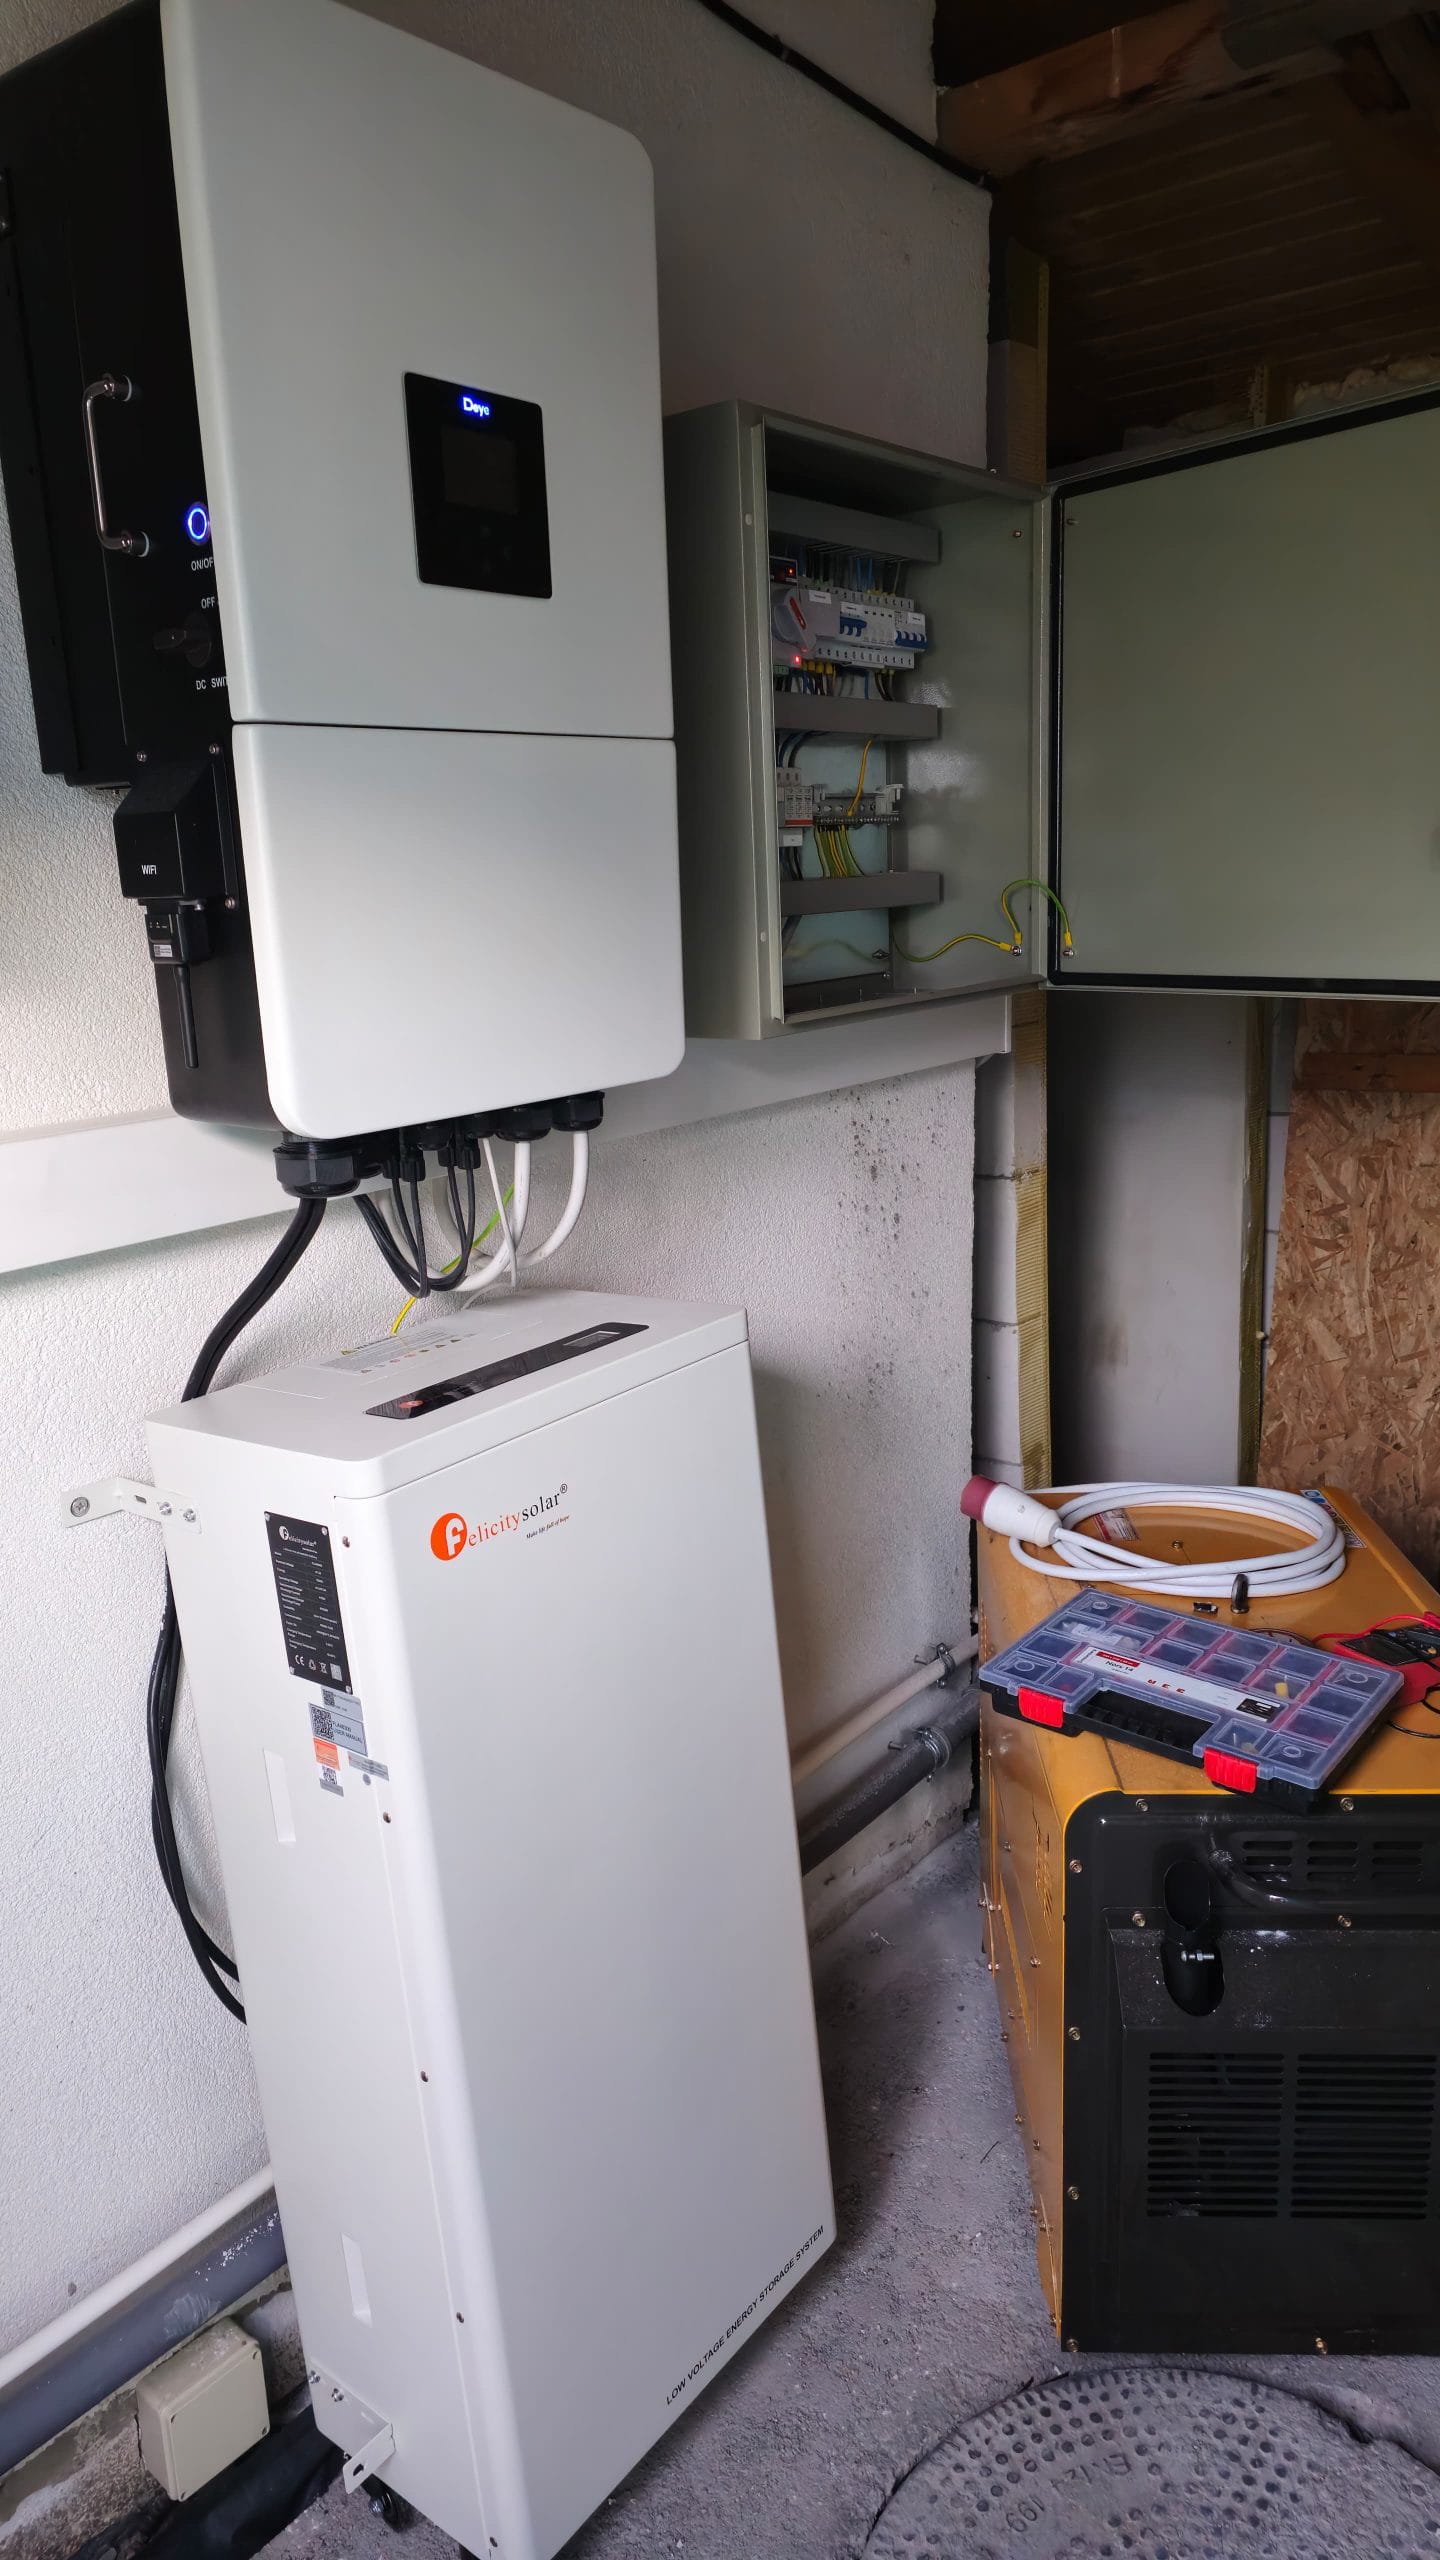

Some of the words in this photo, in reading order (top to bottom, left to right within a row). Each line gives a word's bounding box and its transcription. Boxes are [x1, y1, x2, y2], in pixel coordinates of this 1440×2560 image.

[191, 556, 214, 571] ON/OF
[201, 596, 215, 609] OFF
[195, 679, 207, 690] DC
[211, 676, 227, 688] SWI
[666, 2377, 687, 2405] LOW
[687, 2336, 725, 2380] VOLTAGE
[725, 2298, 758, 2339] ENERGY
[759, 2258, 795, 2302] STORAGE
[795, 2224, 824, 2261] SYSTEM
